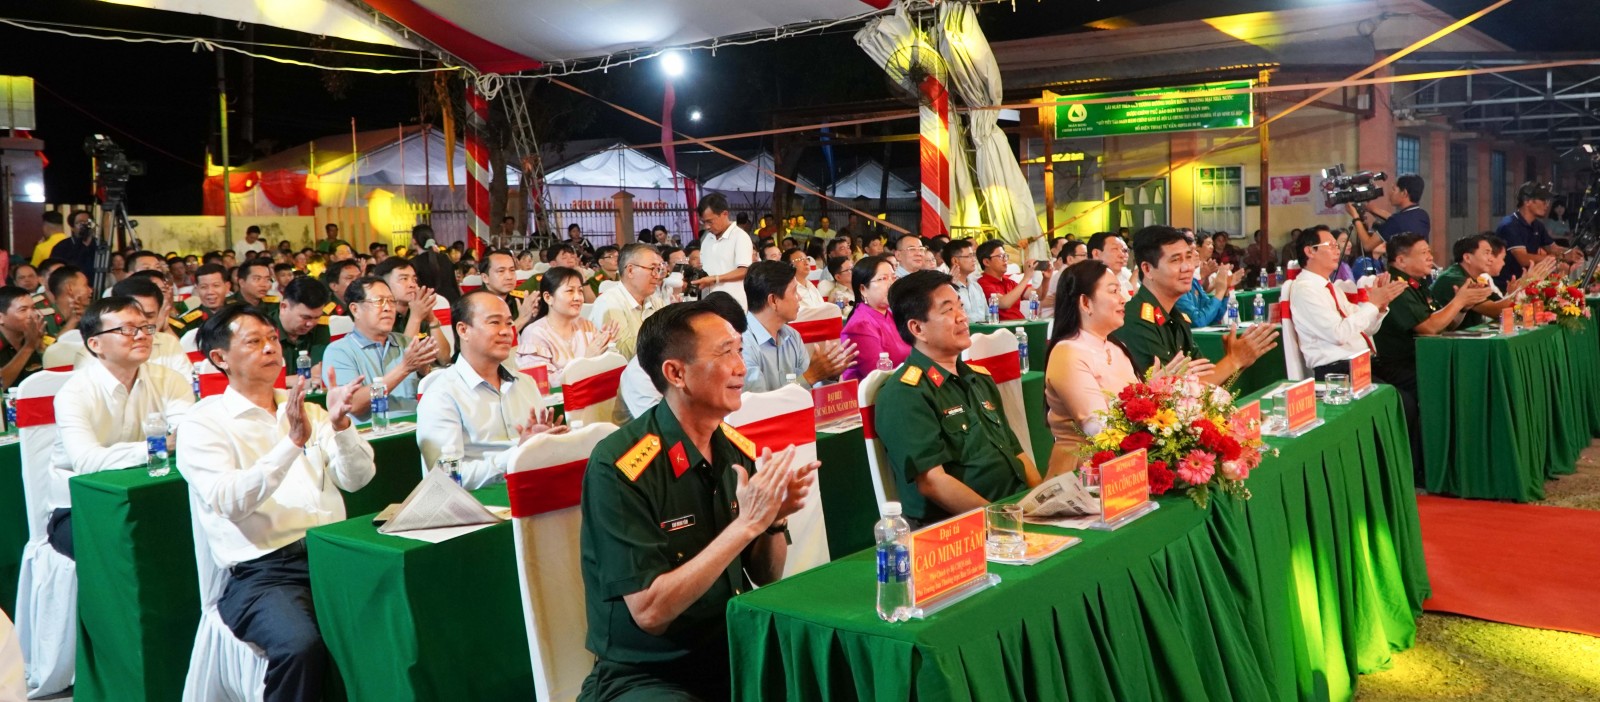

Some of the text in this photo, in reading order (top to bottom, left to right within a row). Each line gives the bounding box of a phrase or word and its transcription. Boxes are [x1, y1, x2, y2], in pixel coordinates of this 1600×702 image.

[940, 523, 960, 540] Đại tá
[915, 550, 936, 573] CAO
[938, 540, 962, 564] MINH
[964, 530, 983, 553] TÂM
